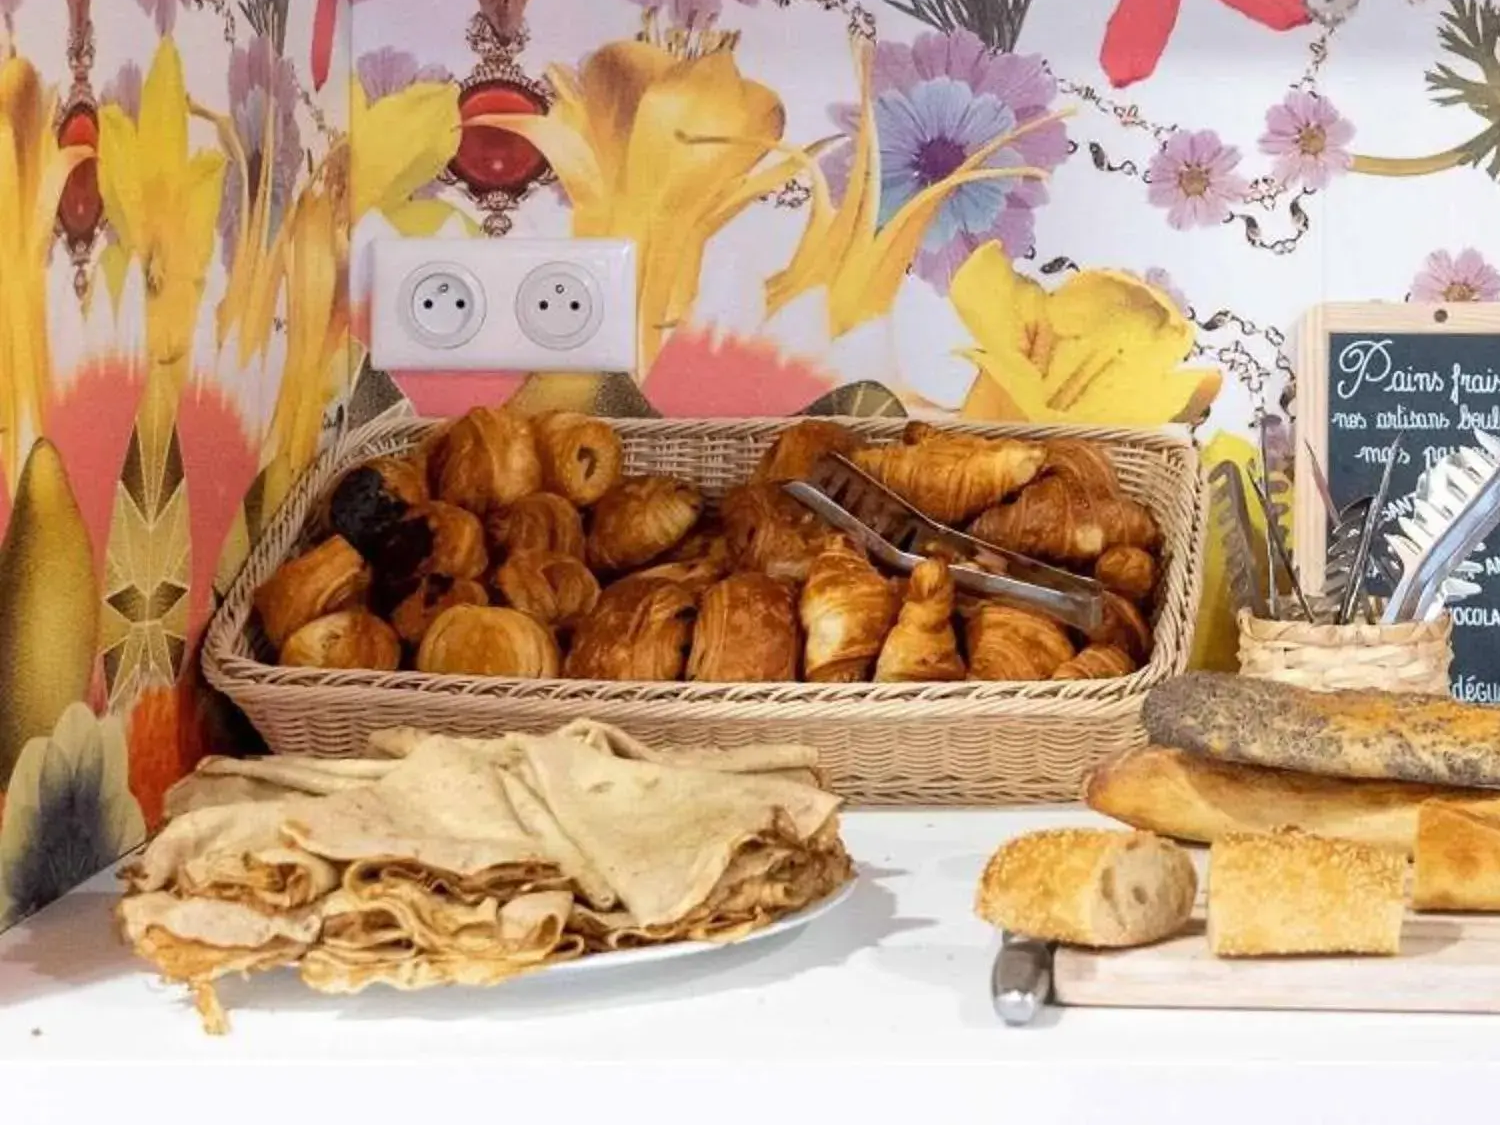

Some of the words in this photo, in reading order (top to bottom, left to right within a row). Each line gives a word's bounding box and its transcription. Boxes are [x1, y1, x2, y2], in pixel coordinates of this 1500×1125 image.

[1336, 338, 1445, 400] Pains
[1331, 411, 1368, 430] nos
[1375, 405, 1451, 431] artisans
[1353, 445, 1411, 465] mas
